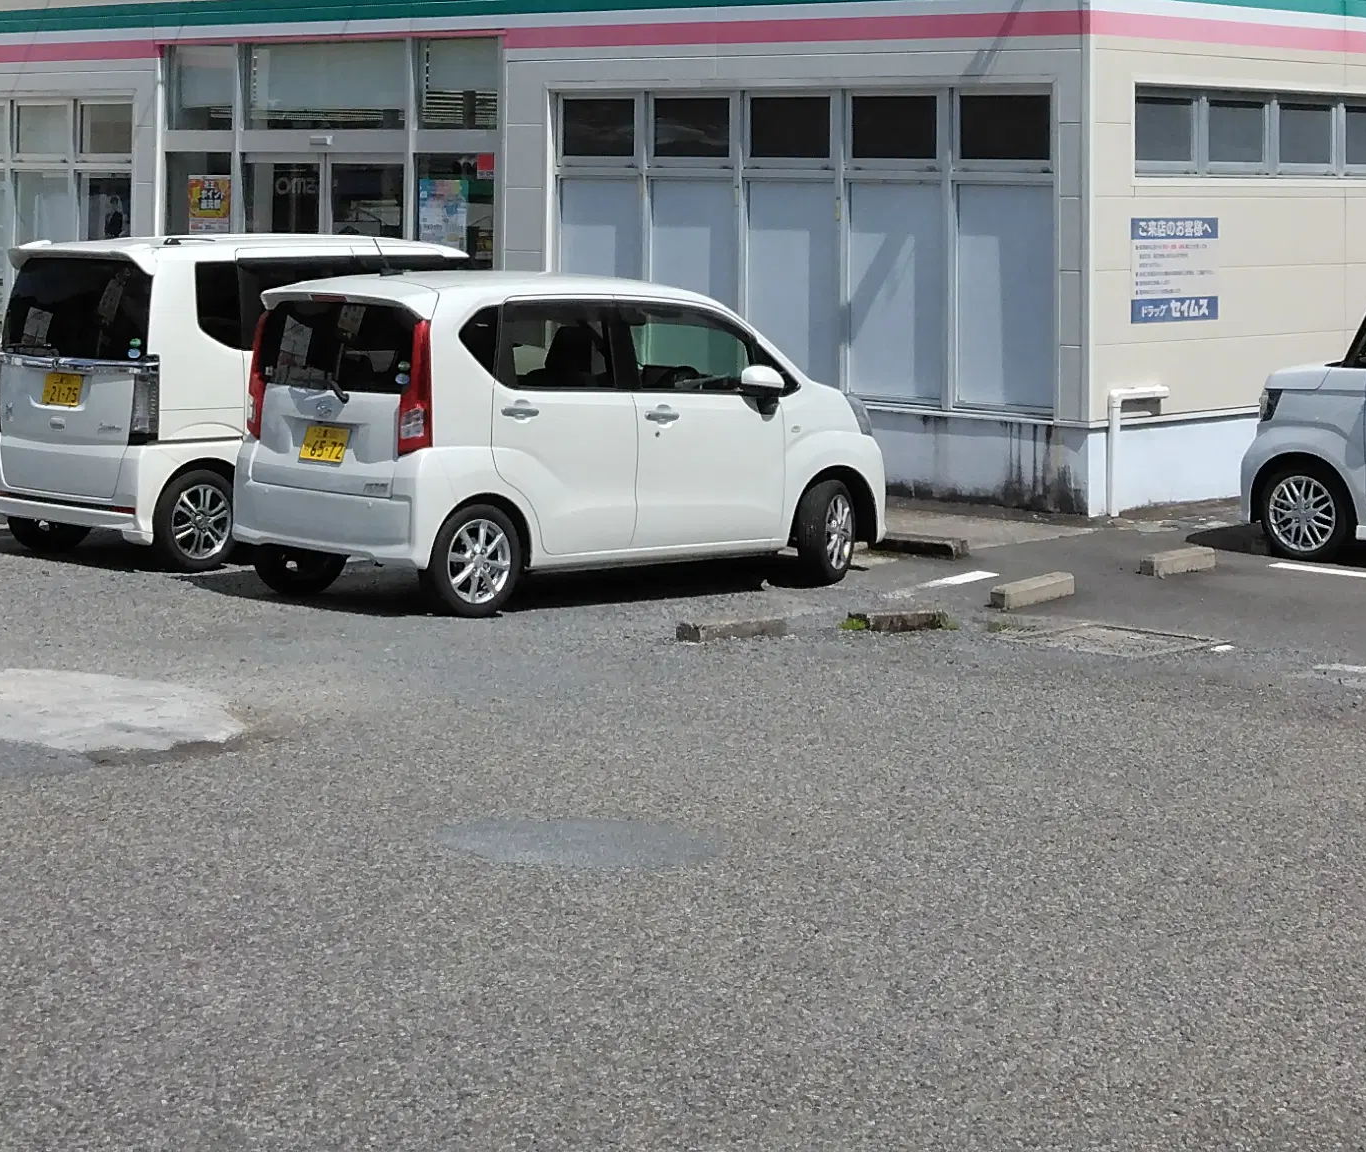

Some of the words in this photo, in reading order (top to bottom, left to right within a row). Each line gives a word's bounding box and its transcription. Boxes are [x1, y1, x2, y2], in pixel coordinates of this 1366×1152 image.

[1139, 220, 1212, 237] ご来店のお客様へ
[1170, 299, 1209, 318] セイムス
